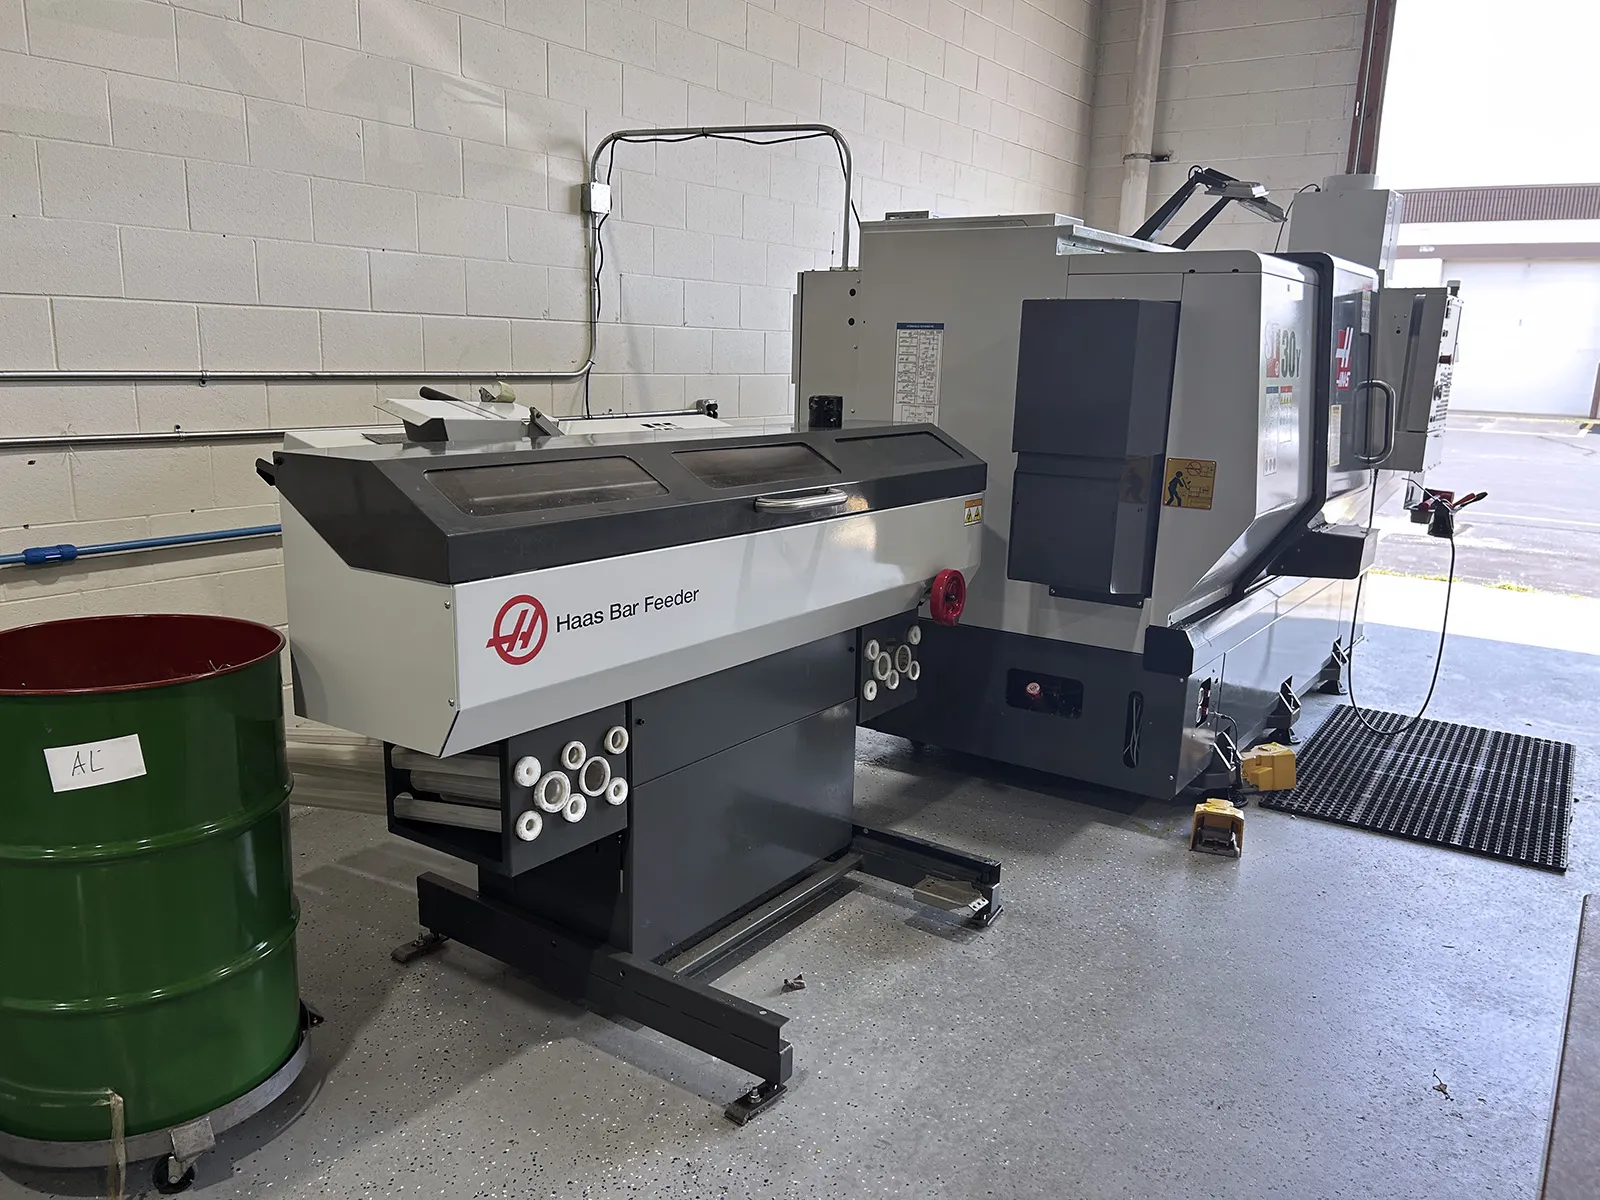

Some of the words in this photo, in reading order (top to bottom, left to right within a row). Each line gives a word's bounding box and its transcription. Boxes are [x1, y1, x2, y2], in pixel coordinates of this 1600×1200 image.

[1281, 330, 1301, 378] 30Y
[556, 610, 604, 633] Haas
[610, 602, 639, 620] Bar
[644, 588, 699, 612] Feeder
